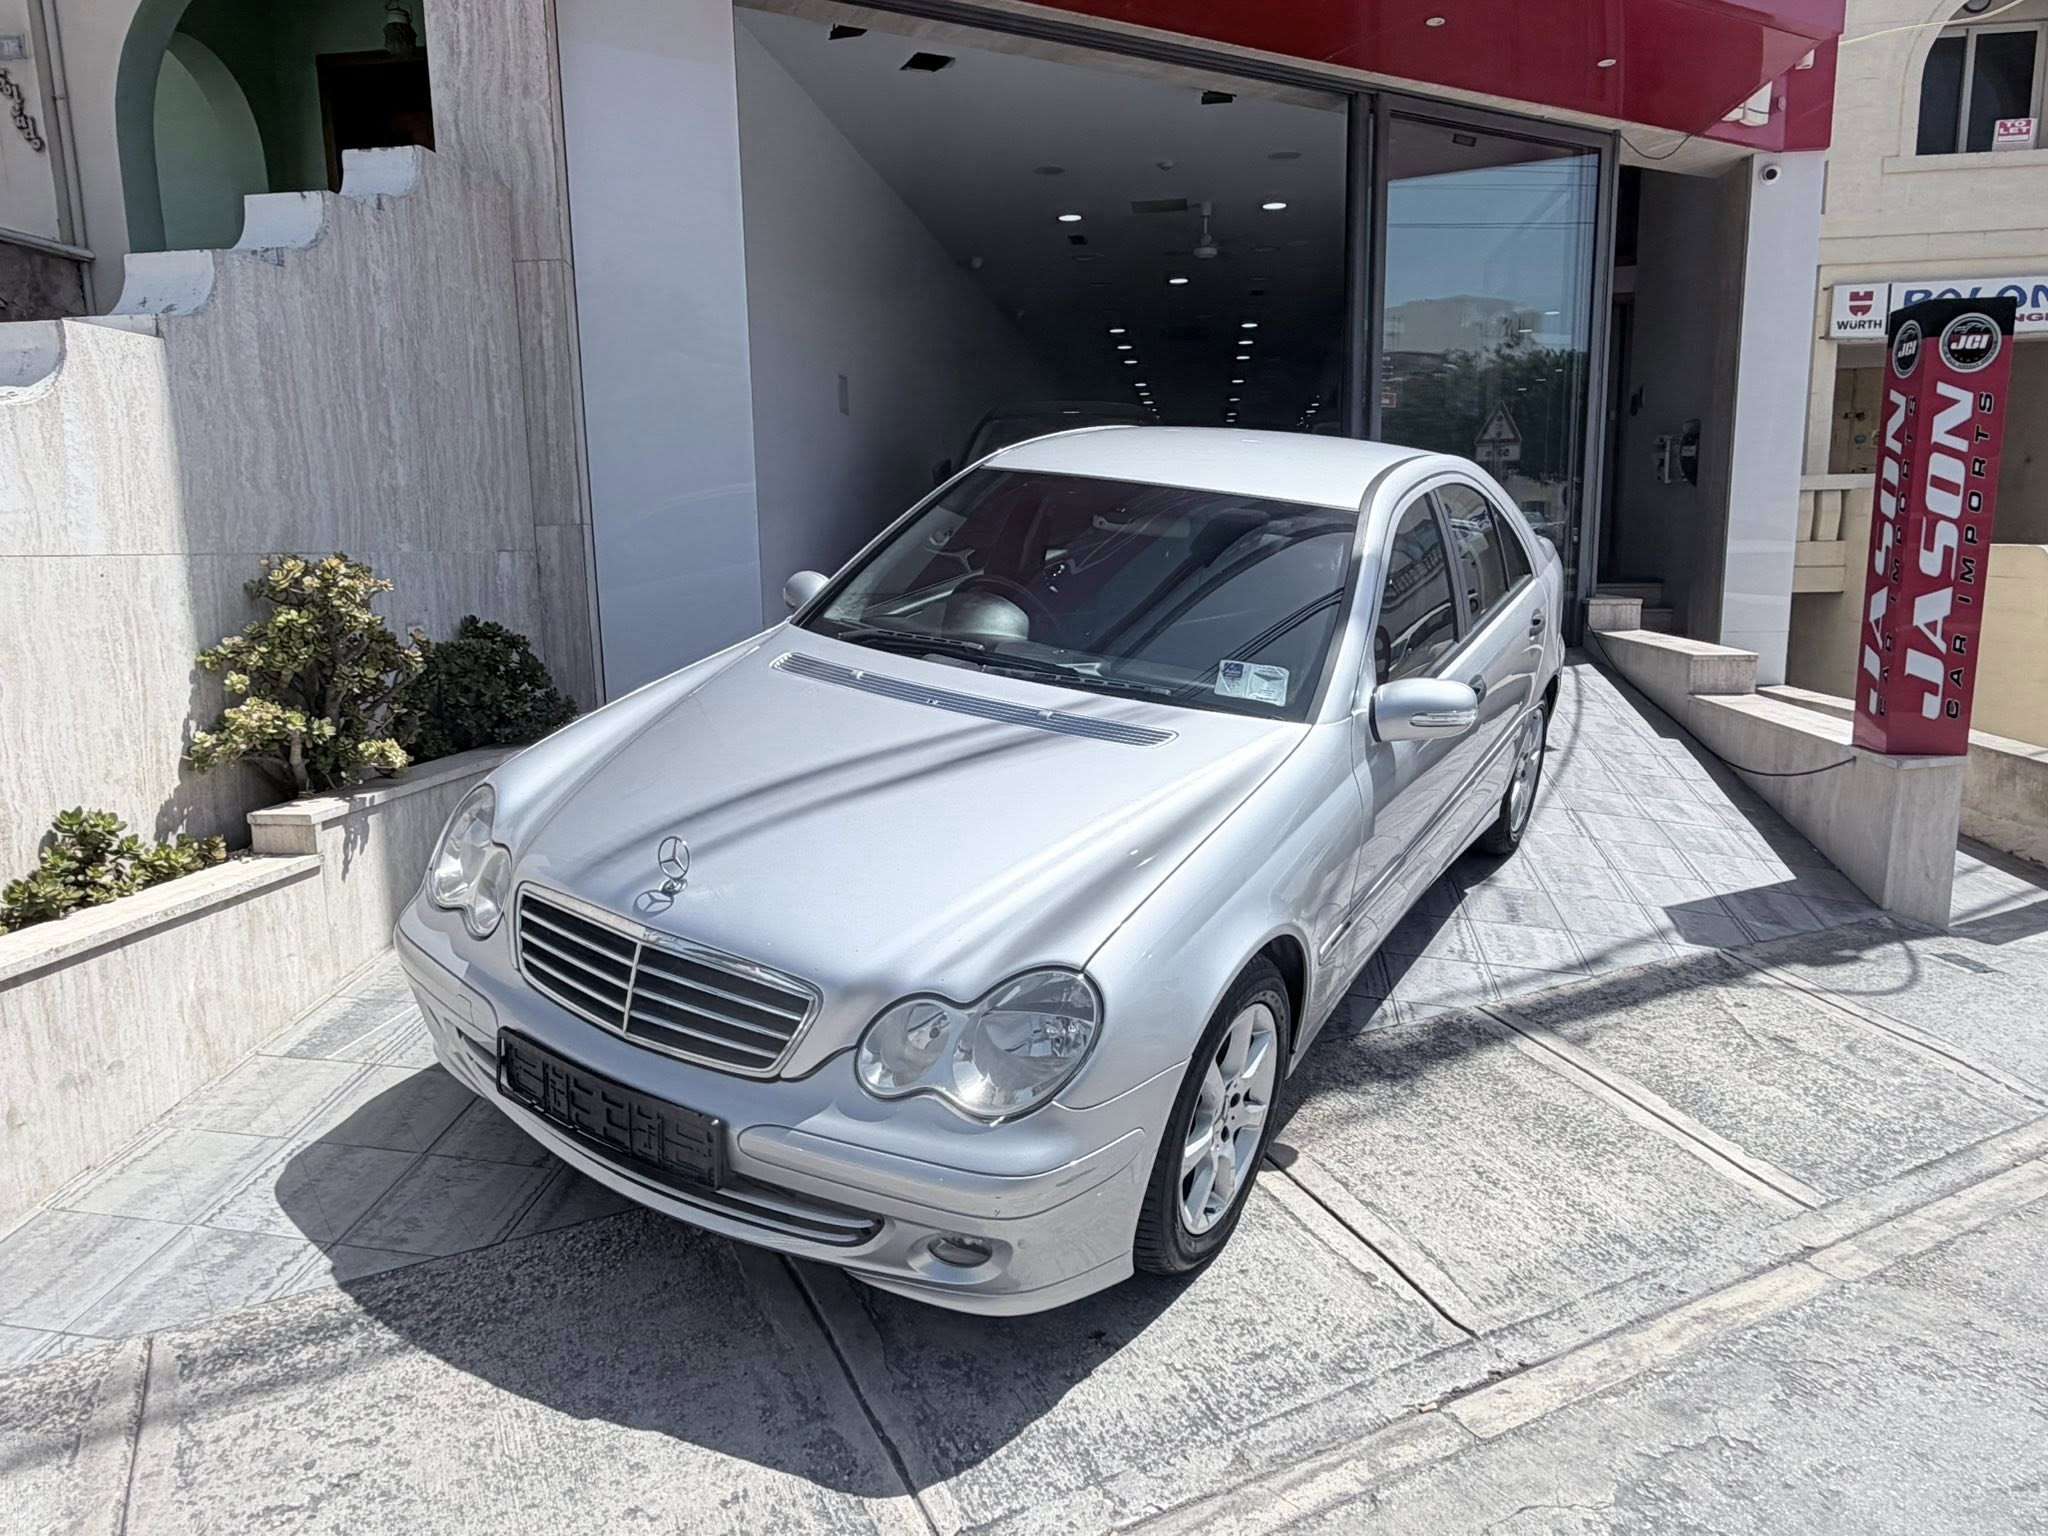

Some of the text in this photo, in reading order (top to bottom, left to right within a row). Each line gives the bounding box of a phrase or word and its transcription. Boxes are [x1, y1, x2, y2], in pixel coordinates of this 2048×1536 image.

[1999, 126, 2030, 135] LET
[2004, 120, 2026, 128] TO
[1898, 340, 1917, 358] JCI
[1950, 334, 1990, 350] JCI
[1864, 389, 1907, 715] JASON
[1904, 380, 1974, 721] JASON
[1946, 634, 1968, 719] CAR
[1957, 391, 1994, 604] IMPORTS
